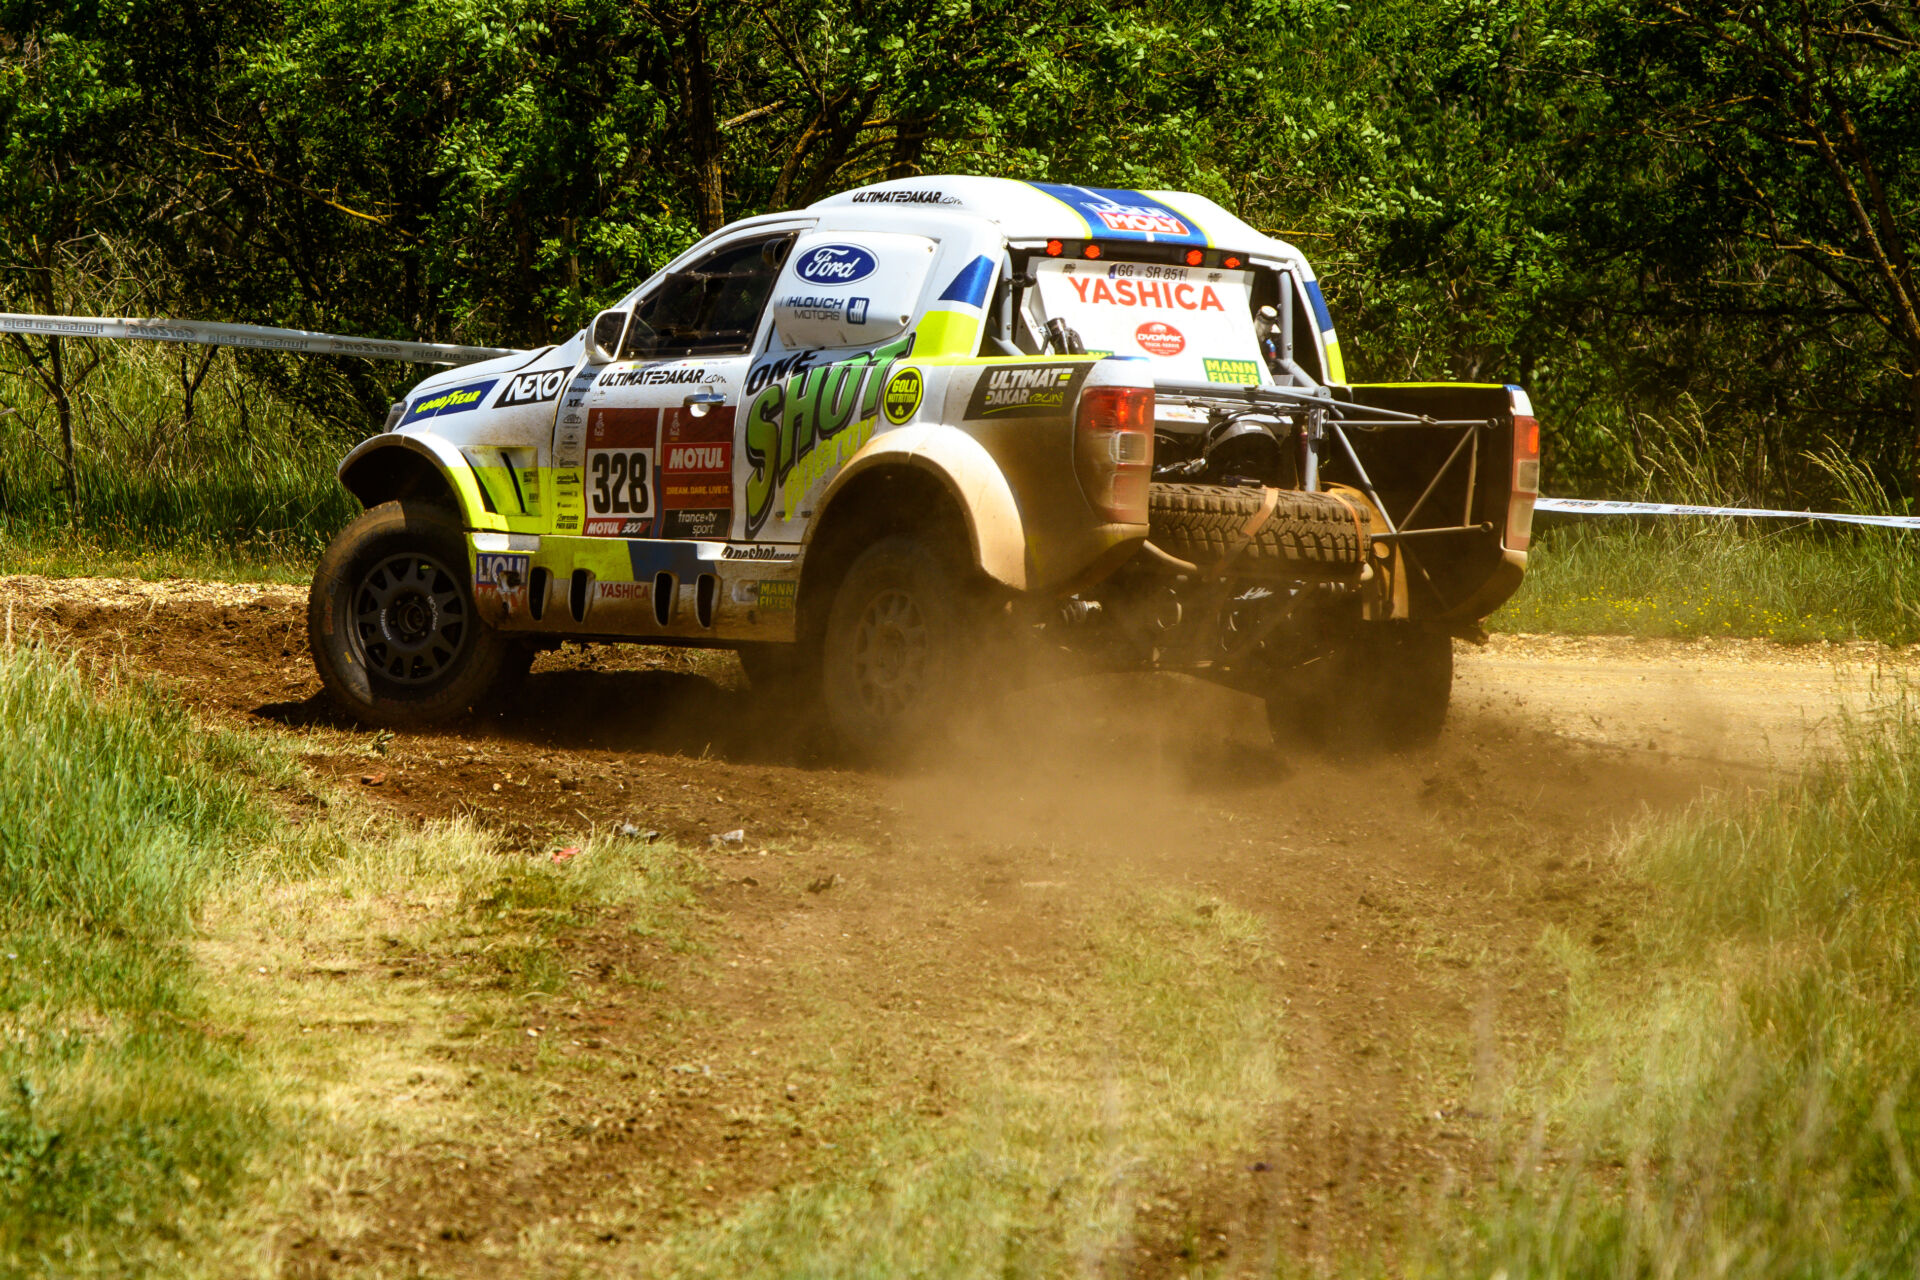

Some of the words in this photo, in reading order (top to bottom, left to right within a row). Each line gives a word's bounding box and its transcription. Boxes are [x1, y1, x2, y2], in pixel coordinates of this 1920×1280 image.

[1102, 213, 1181, 232] MOLY
[805, 248, 861, 278] Ford
[1117, 265, 1134, 277] GG
[1145, 266, 1161, 278] SR
[788, 296, 845, 309] HLOUCH
[1068, 277, 1225, 311] YASHICA
[794, 310, 840, 320] MOTORS
[746, 346, 826, 396] ONE
[1206, 360, 1258, 375] MANN
[505, 370, 566, 402] NEXO
[892, 379, 918, 392] GOLD
[989, 368, 1074, 390] ULTIMATE
[1208, 371, 1260, 385] FILTER
[415, 389, 482, 415] GOODYEAR
[984, 388, 1030, 405] DAKAR
[746, 332, 917, 538] SHOT
[669, 448, 724, 469] MOTUL
[592, 453, 649, 514] 328
[587, 522, 620, 534] MOTUL
[692, 524, 714, 537] sport
[479, 556, 527, 583] LIQUI
[600, 582, 650, 600] YASHICA
[761, 583, 794, 595] MANN
